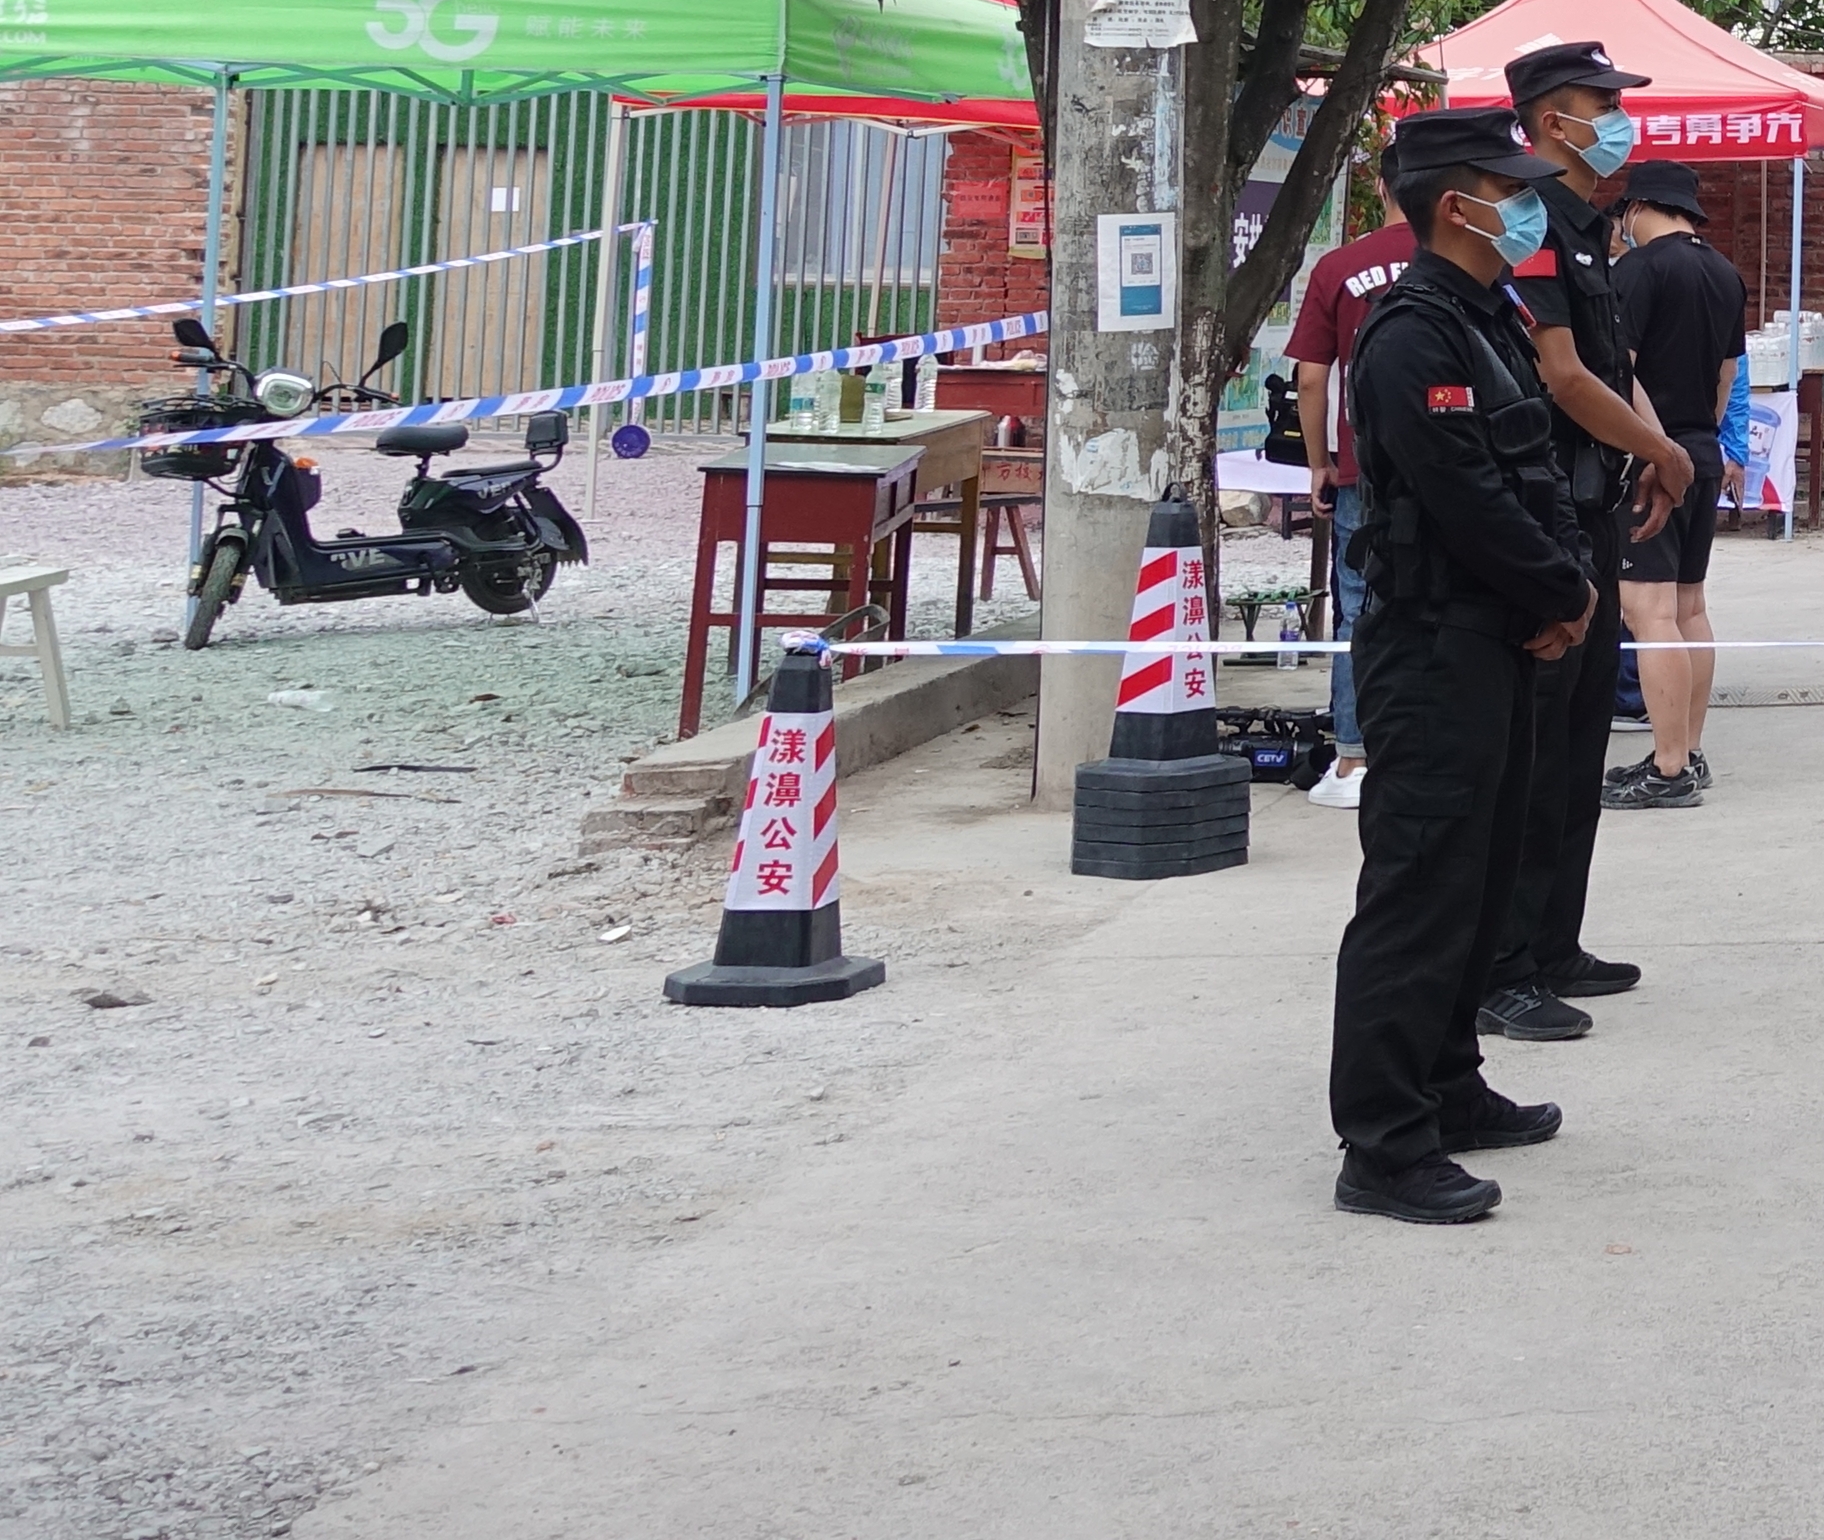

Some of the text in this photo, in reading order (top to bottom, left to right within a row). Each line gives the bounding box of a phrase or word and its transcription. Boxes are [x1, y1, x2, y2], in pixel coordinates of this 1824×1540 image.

[526, 15, 648, 40] 赋能未来
[1345, 265, 1386, 298] RED
[756, 727, 807, 896] 漾濞公安
